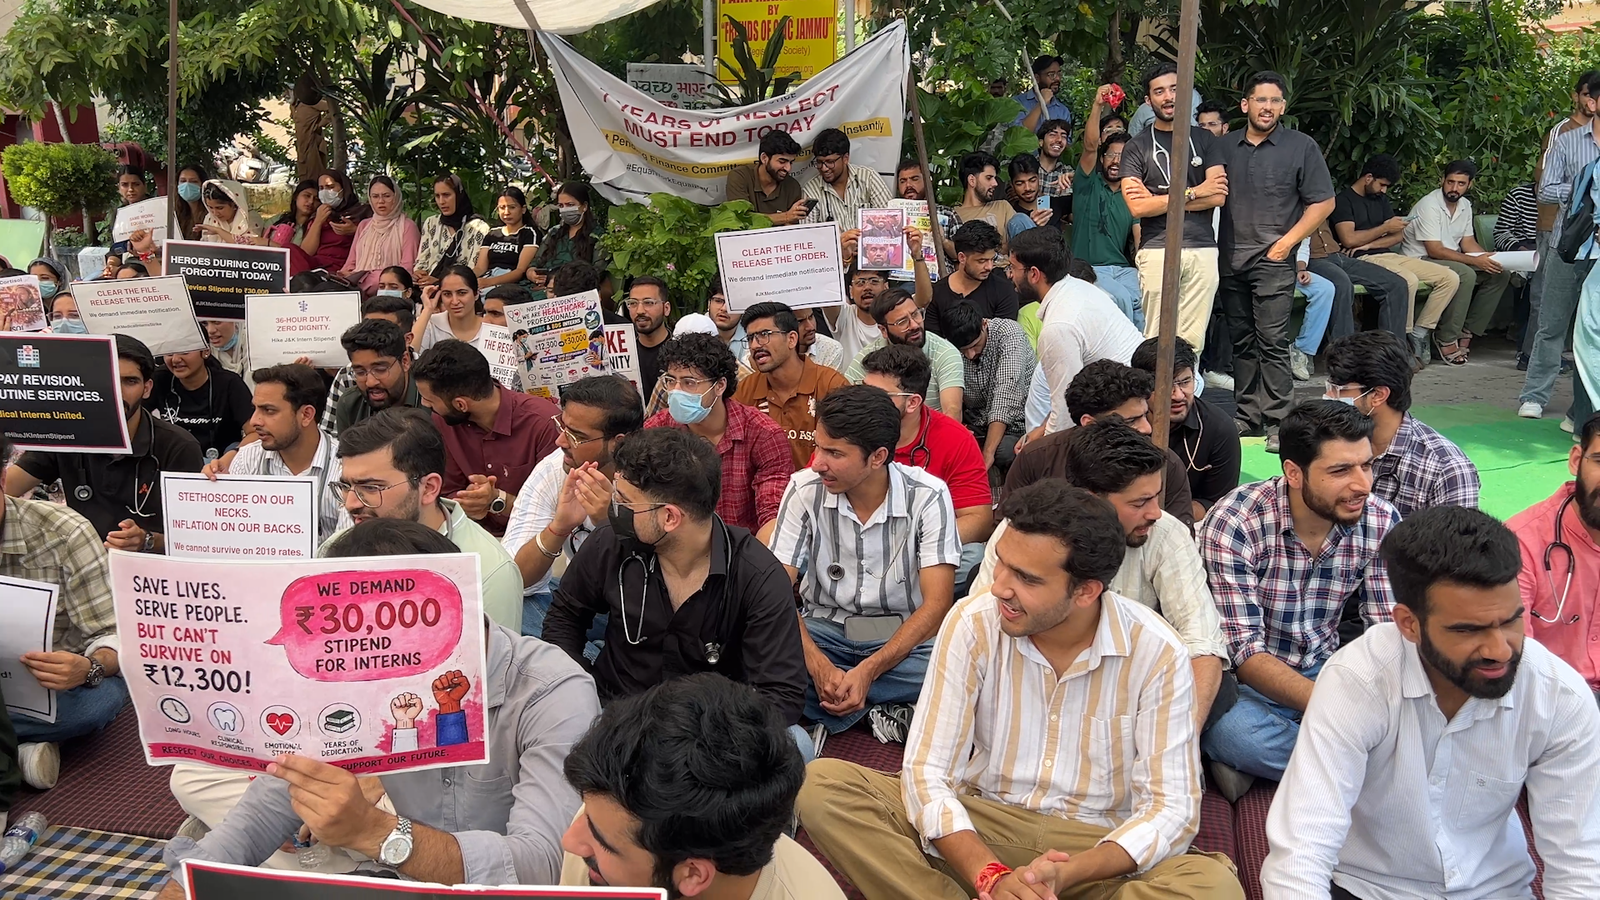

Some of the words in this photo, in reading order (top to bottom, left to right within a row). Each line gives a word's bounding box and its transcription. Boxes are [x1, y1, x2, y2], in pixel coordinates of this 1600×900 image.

[768, 5, 779, 15] BY
[761, 18, 772, 40] OF
[783, 45, 811, 56] Society)
[624, 117, 682, 148] MUST
[690, 131, 737, 147] END
[843, 119, 885, 136] Instantly
[649, 155, 689, 173] Finance
[742, 246, 772, 257] CLEAR
[774, 244, 792, 252] THE
[794, 242, 816, 250] FILE.
[170, 256, 211, 266] HEROES
[213, 258, 249, 269] DURING
[252, 262, 282, 272] COVID.
[732, 258, 773, 268] RELEASE
[774, 256, 792, 264] THE
[794, 252, 828, 262] ORDER.
[180, 267, 238, 279] FORGOTTEN
[241, 272, 273, 282] TODAY.
[739, 274, 764, 282] demand
[766, 270, 798, 280] immediate
[798, 266, 836, 276] notification.
[97, 288, 122, 297] CLEAR
[140, 286, 160, 294] FILE.
[208, 285, 234, 294] Stipend
[90, 298, 124, 306] RELEASE
[142, 294, 172, 302] ORDER.
[120, 308, 148, 316] immediate
[148, 306, 182, 314] notification.
[531, 310, 540, 318] ARE
[542, 300, 586, 316] HEALTHCARE
[276, 316, 308, 324] 36-HOUR
[527, 310, 578, 326] PROFESSIONALS!
[298, 324, 330, 332] DIGNITY.
[490, 330, 498, 338] THE
[484, 340, 497, 350] THE
[535, 341, 558, 351] ₹12,300
[564, 334, 586, 345] ₹30,000
[498, 354, 506, 364] IS
[492, 366, 510, 376] REVISE
[0, 374, 20, 385] PAY
[22, 374, 84, 387] REVISION.
[38, 390, 104, 402] SERVICES.
[20, 411, 51, 419] Interns
[53, 412, 85, 420] United.
[4, 432, 75, 440] #HikeJKInternStipend
[178, 492, 248, 504] STETHOSCOPE
[252, 494, 267, 504] ON
[270, 495, 294, 505] OUR
[214, 508, 251, 518] NECKS.
[172, 520, 218, 531] INFLATION
[220, 522, 236, 532] ON
[238, 522, 260, 533] OUR
[264, 524, 304, 534] BACKS.
[174, 542, 184, 550] We
[186, 544, 210, 552] cannot
[212, 546, 240, 554] survive
[256, 547, 276, 556] 2019
[278, 548, 304, 556] rates.
[133, 575, 170, 596] SAVE
[176, 580, 226, 600] LIVES.
[317, 582, 341, 597] WE
[350, 578, 416, 596] DEMAND
[135, 598, 179, 619] SERVE
[185, 604, 248, 624] PEOPLE.
[294, 598, 442, 636] ₹30,000
[137, 622, 166, 640] BUT
[173, 626, 218, 644] CAN'T
[324, 636, 392, 654] STIPEND
[140, 643, 204, 662] SURVIVE
[210, 650, 232, 664] ON
[316, 658, 346, 673] FOR
[354, 652, 422, 670] INTERNS
[143, 664, 251, 694] ₹12,300!
[164, 726, 182, 734] LONG
[211, 740, 254, 754] RESPONSIBILITY
[217, 735, 244, 745] CLINICAL
[264, 742, 302, 750] EMOTIONAL
[162, 745, 197, 756] RESPECT
[200, 752, 216, 761] OUR
[220, 755, 254, 768] CHOICES.
[321, 746, 363, 757] DEDICATION
[342, 760, 382, 771] SUPPORT
[388, 755, 406, 764] OUR
[410, 750, 450, 761] FUTURE.
